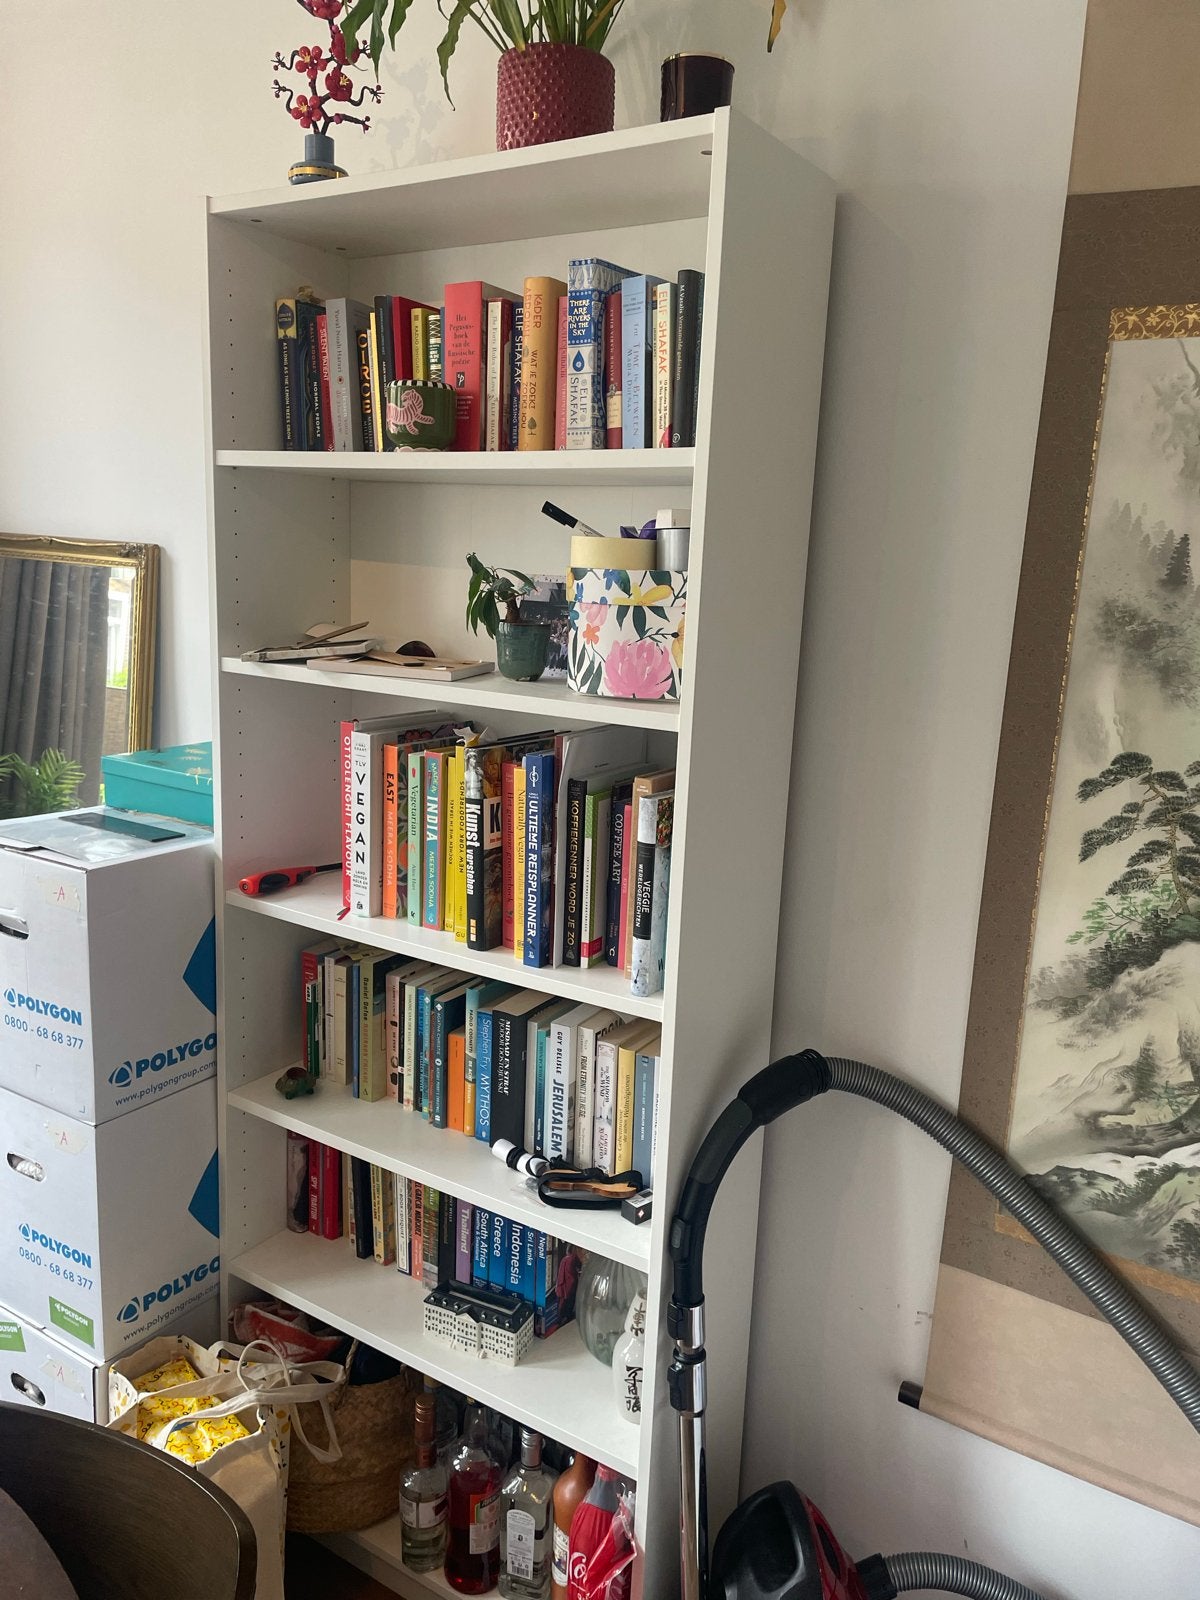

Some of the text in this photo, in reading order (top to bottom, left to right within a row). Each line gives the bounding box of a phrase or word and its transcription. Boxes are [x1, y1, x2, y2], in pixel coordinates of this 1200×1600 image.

[533, 294, 542, 328] KADER
[569, 314, 591, 322] RIVERS
[570, 299, 590, 307] THERE
[573, 307, 587, 315] ARE
[658, 290, 668, 374] ELIF SHAFAK
[321, 354, 329, 381] PATIENT
[514, 335, 522, 384] SHAFAK
[530, 350, 538, 367] WAT
[530, 371, 537, 379] JE
[570, 377, 579, 425] SHAFAK
[579, 388, 588, 413] ELIF
[344, 736, 352, 817] OTTOLENGHI
[355, 771, 366, 864] VEGAN
[410, 785, 418, 836] Vegetarian
[427, 795, 438, 842] INDIA
[517, 789, 525, 864] Naturally Vegan
[527, 800, 538, 850] ULTIEME
[465, 803, 481, 895] Kunst verstehen
[569, 800, 579, 879] KOFFIEKENNER
[612, 813, 623, 884] COFFEE ART
[527, 854, 538, 937] REISPLANNER
[569, 883, 577, 913] WORD
[635, 864, 643, 928] WERELDGERECHTEN
[641, 880, 651, 913] VEGGIE
[568, 916, 576, 928] JE
[568, 932, 575, 945] ZO
[4, 1014, 28, 1032] 0800
[37, 1026, 48, 1039] 68
[51, 1031, 63, 1044] 68
[66, 1035, 83, 1049] 377
[17, 993, 82, 1026] POLYGON
[480, 1018, 490, 1070] Stephen Fry
[505, 1058, 509, 1068] EN
[115, 1061, 216, 1106] www.polygongroup.com
[480, 1073, 490, 1126] MYTHOS
[551, 1079, 564, 1152] JERUSALEM
[32, 1229, 92, 1268] POLYGON
[461, 1209, 469, 1253] Thailand
[480, 1212, 489, 1268] South Africa
[493, 1217, 504, 1257] Greece
[19, 1247, 42, 1266] 0800
[49, 1263, 61, 1276] 68
[64, 1269, 74, 1282] 68
[77, 1275, 93, 1290] 377
[511, 1224, 523, 1284] Indonesia
[61, 1307, 89, 1326] POLYGON
